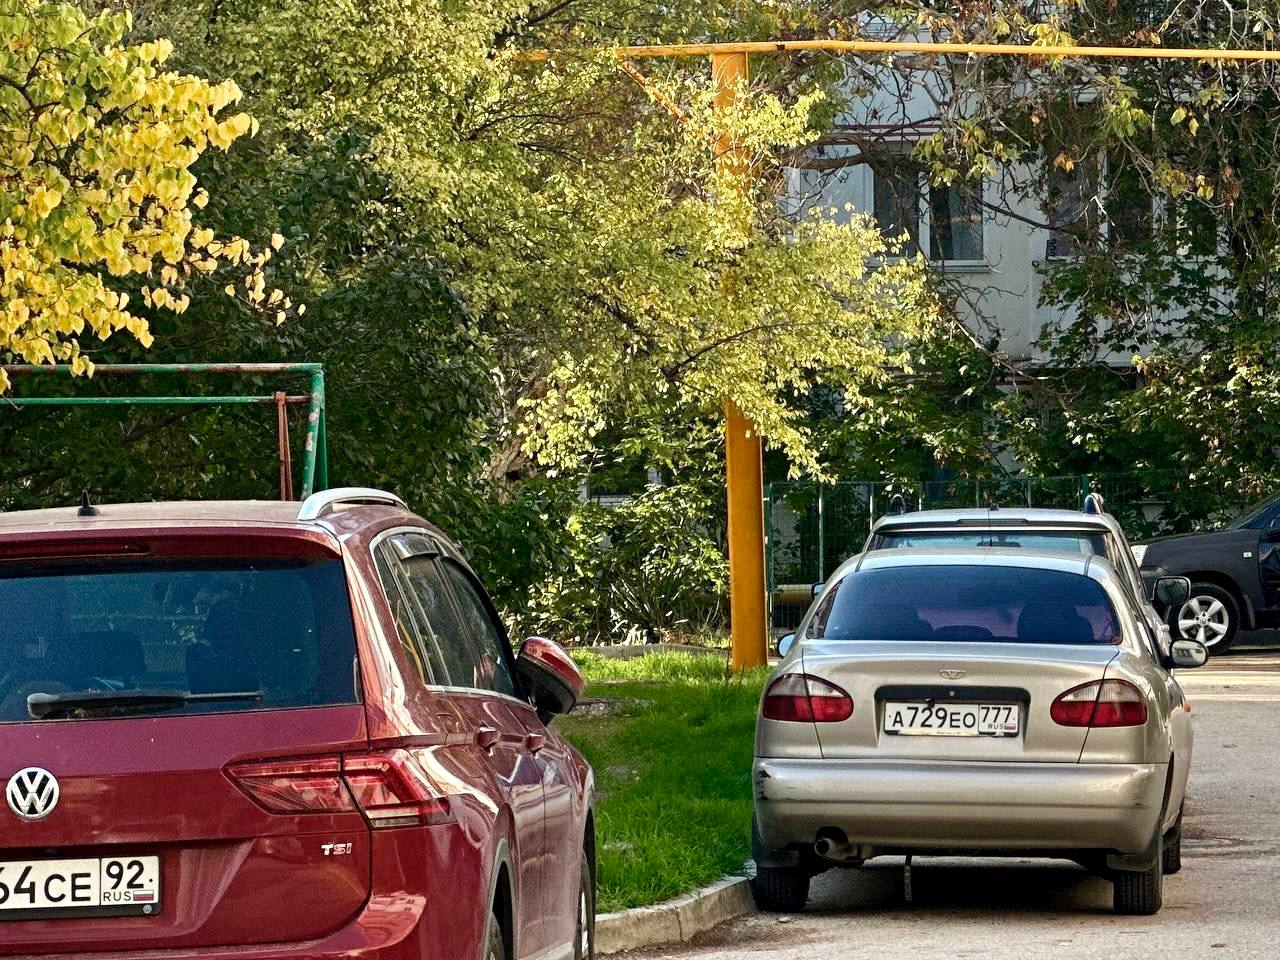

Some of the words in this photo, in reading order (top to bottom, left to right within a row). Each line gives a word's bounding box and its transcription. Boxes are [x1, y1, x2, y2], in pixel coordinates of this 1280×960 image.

[980, 706, 1012, 723] 777
[105, 860, 144, 890] 92
[103, 891, 132, 902] RUS
